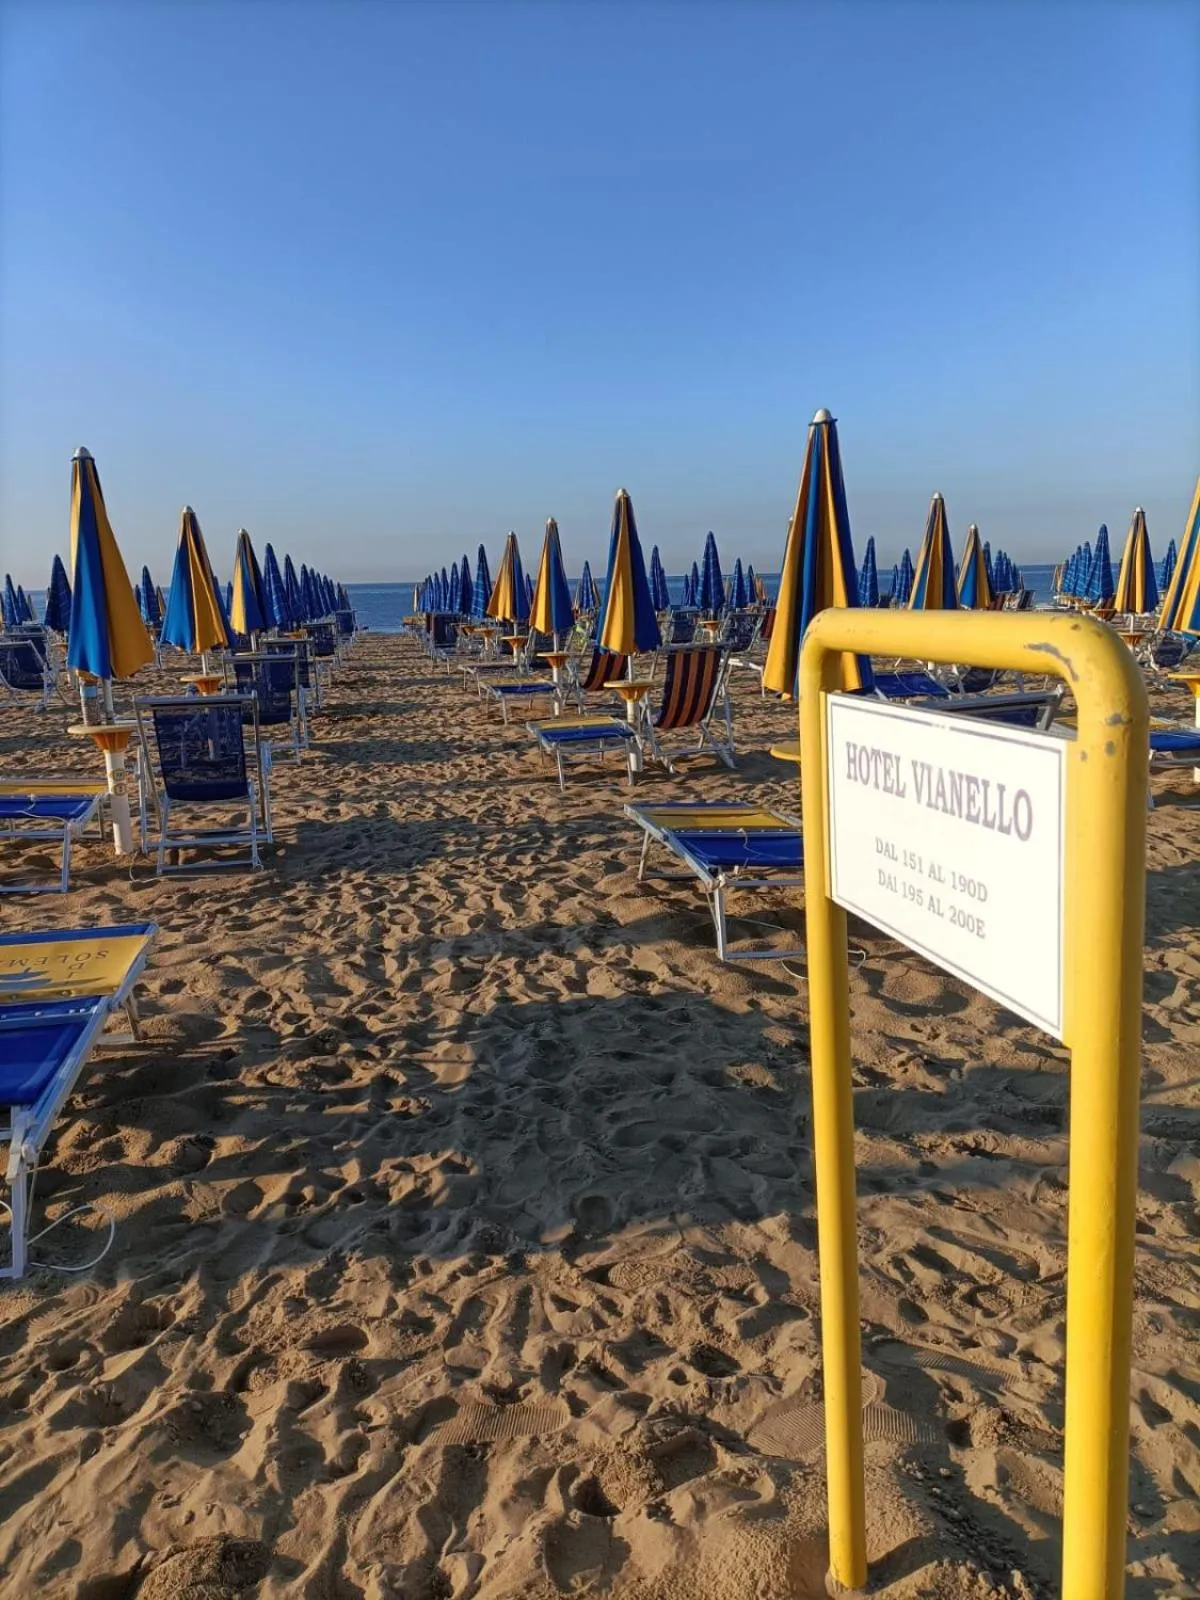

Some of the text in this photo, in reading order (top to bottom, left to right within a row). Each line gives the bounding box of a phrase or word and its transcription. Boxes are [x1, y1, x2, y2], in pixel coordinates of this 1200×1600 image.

[845, 741, 1034, 842] HOTEL VIANELLO
[875, 836, 988, 903] DAL 151 AL 190D
[902, 881, 924, 907] 195
[927, 894, 945, 918] AL
[949, 905, 987, 940] 200E
[0, 950, 109, 967] SOLEM
